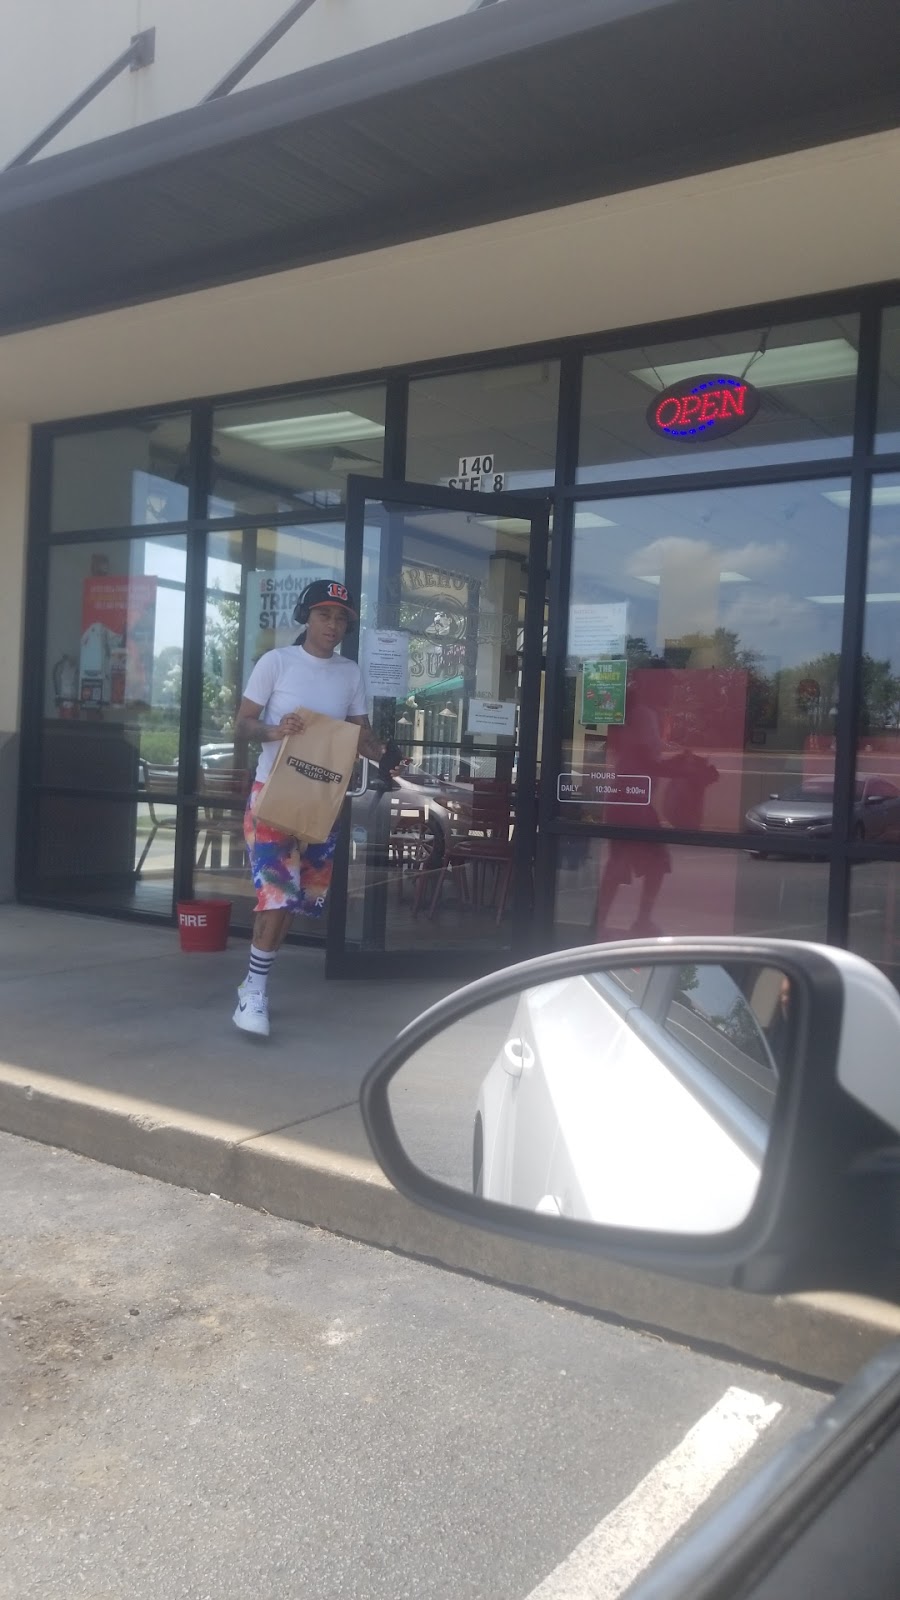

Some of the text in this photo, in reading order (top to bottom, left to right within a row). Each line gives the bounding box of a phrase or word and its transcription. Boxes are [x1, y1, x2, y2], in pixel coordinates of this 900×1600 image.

[655, 386, 748, 428] OPEN
[461, 456, 493, 476] 140
[448, 474, 503, 492] STE 8
[288, 757, 341, 784] FIREHOUSE
[304, 769, 323, 780] SUBS
[590, 772, 616, 780] HOURS
[561, 784, 579, 792] DAILY
[179, 913, 208, 927] FIRE
